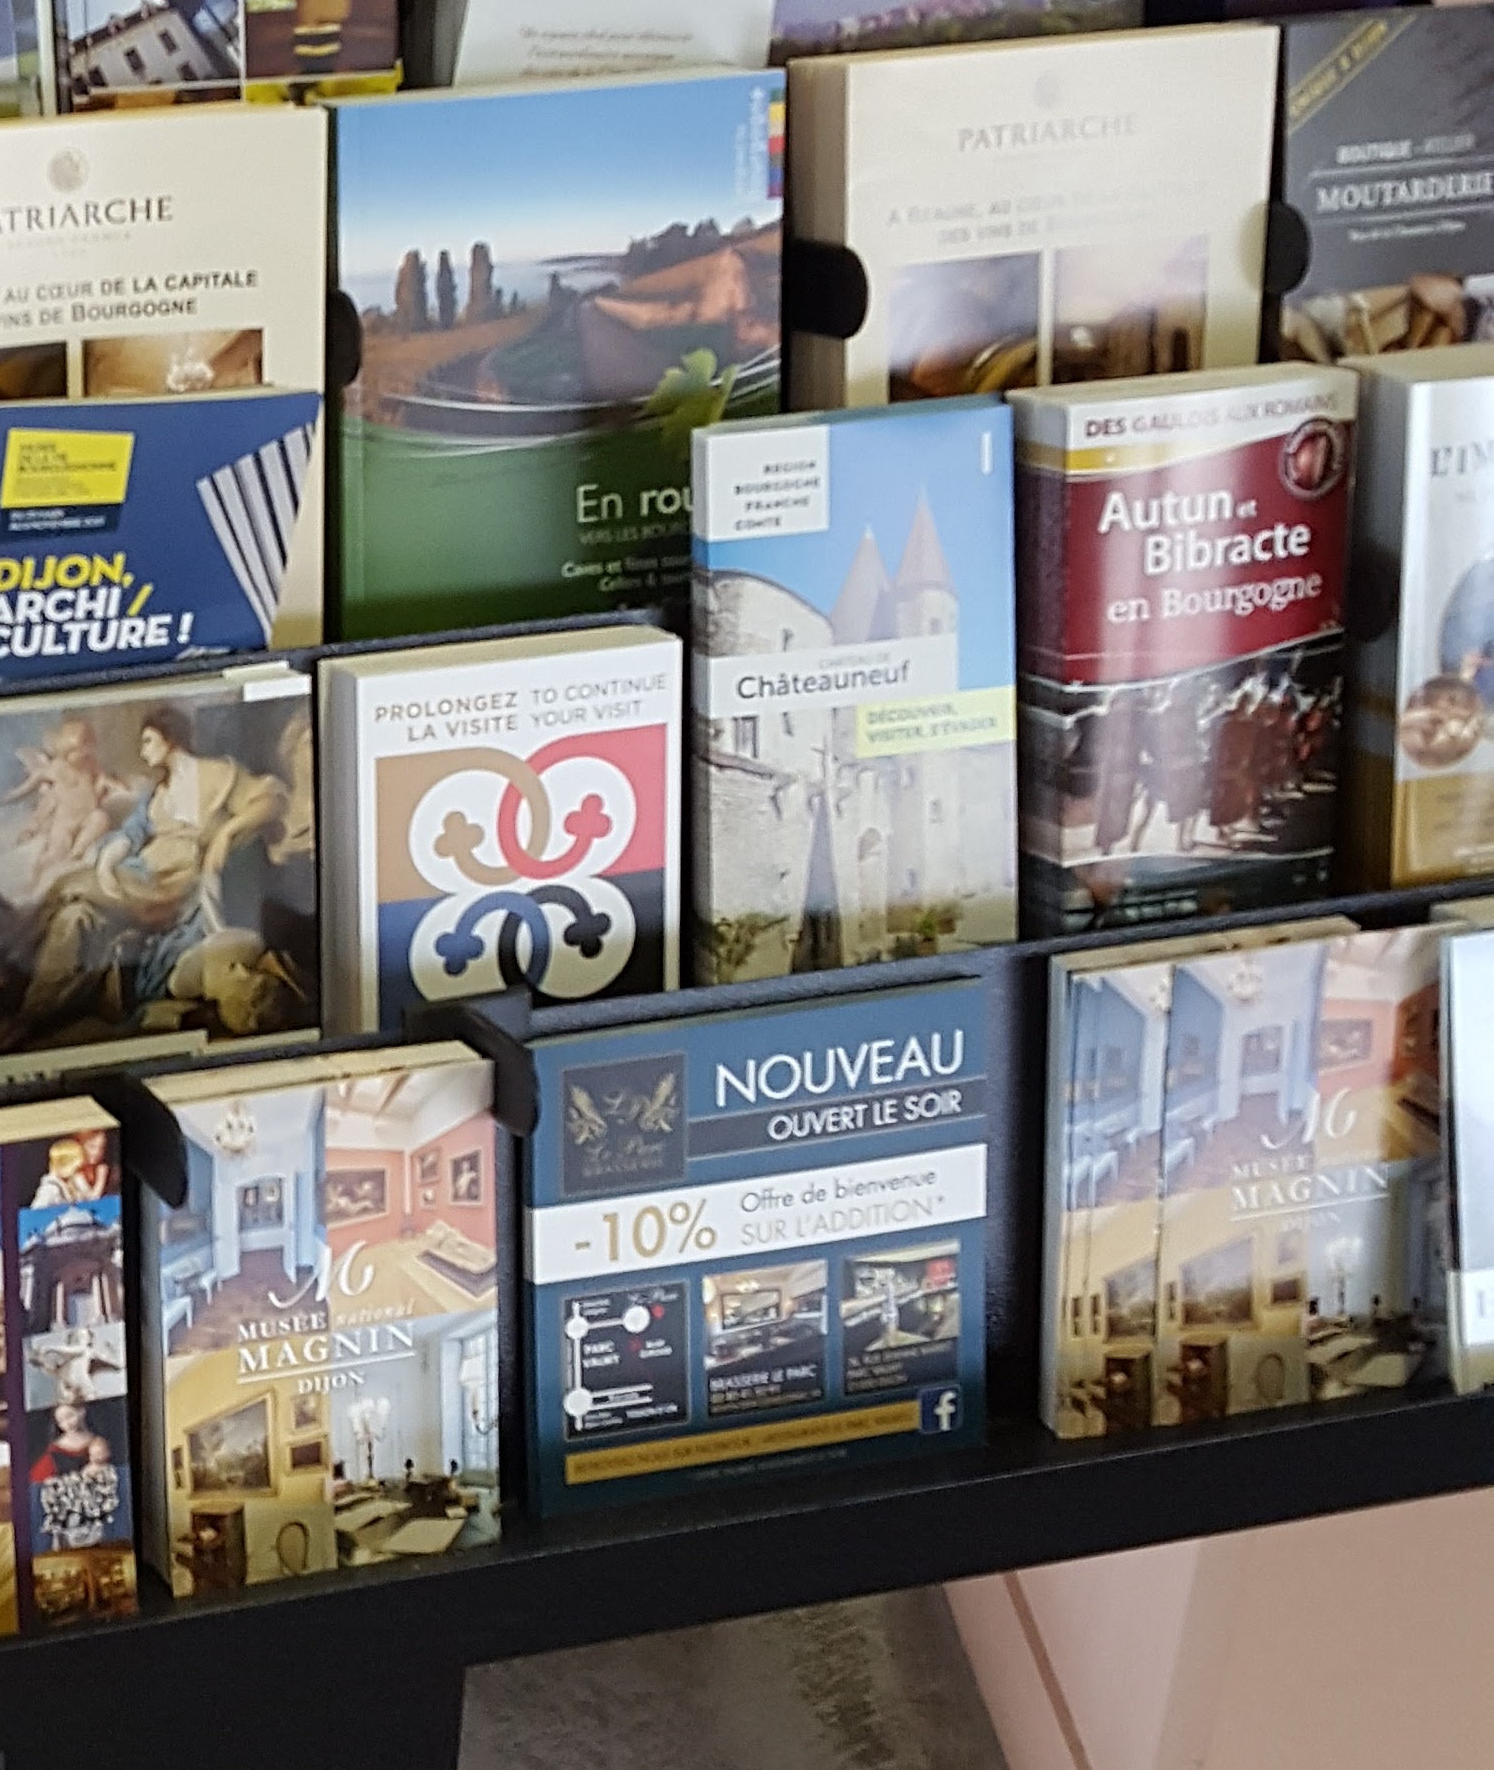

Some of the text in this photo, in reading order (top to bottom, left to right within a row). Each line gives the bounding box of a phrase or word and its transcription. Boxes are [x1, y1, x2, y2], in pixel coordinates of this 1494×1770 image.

[958, 111, 1140, 153] PATRIARCHE
[5, 286, 29, 304] AU
[99, 277, 126, 296] DE
[133, 275, 156, 293] LA
[164, 269, 259, 291] CAPITALE
[39, 308, 65, 326] DE
[70, 296, 198, 324] BOURGOGNE
[1084, 416, 1126, 437] DES
[576, 483, 624, 523] En
[1098, 491, 1258, 534] Autun et
[1144, 522, 1312, 576] Bibracte
[1108, 572, 1324, 623] en Bourgogne
[531, 673, 667, 706] TO CONTINUE
[736, 660, 911, 700] Châteauneuf
[374, 690, 519, 723] PROLONGEZ
[529, 699, 643, 729] YOUR VISIT
[408, 714, 519, 742] LA VISITE
[715, 1029, 964, 1108] NOUVEAU
[767, 1088, 963, 1141] OUVERT LE SOIR
[740, 1168, 938, 1214] Offre de bienvenue
[1228, 1163, 1391, 1214] MAGNIN
[740, 1220, 787, 1247] SUR
[237, 1322, 416, 1374] MAGNIN
[298, 1370, 365, 1395] DIJON
